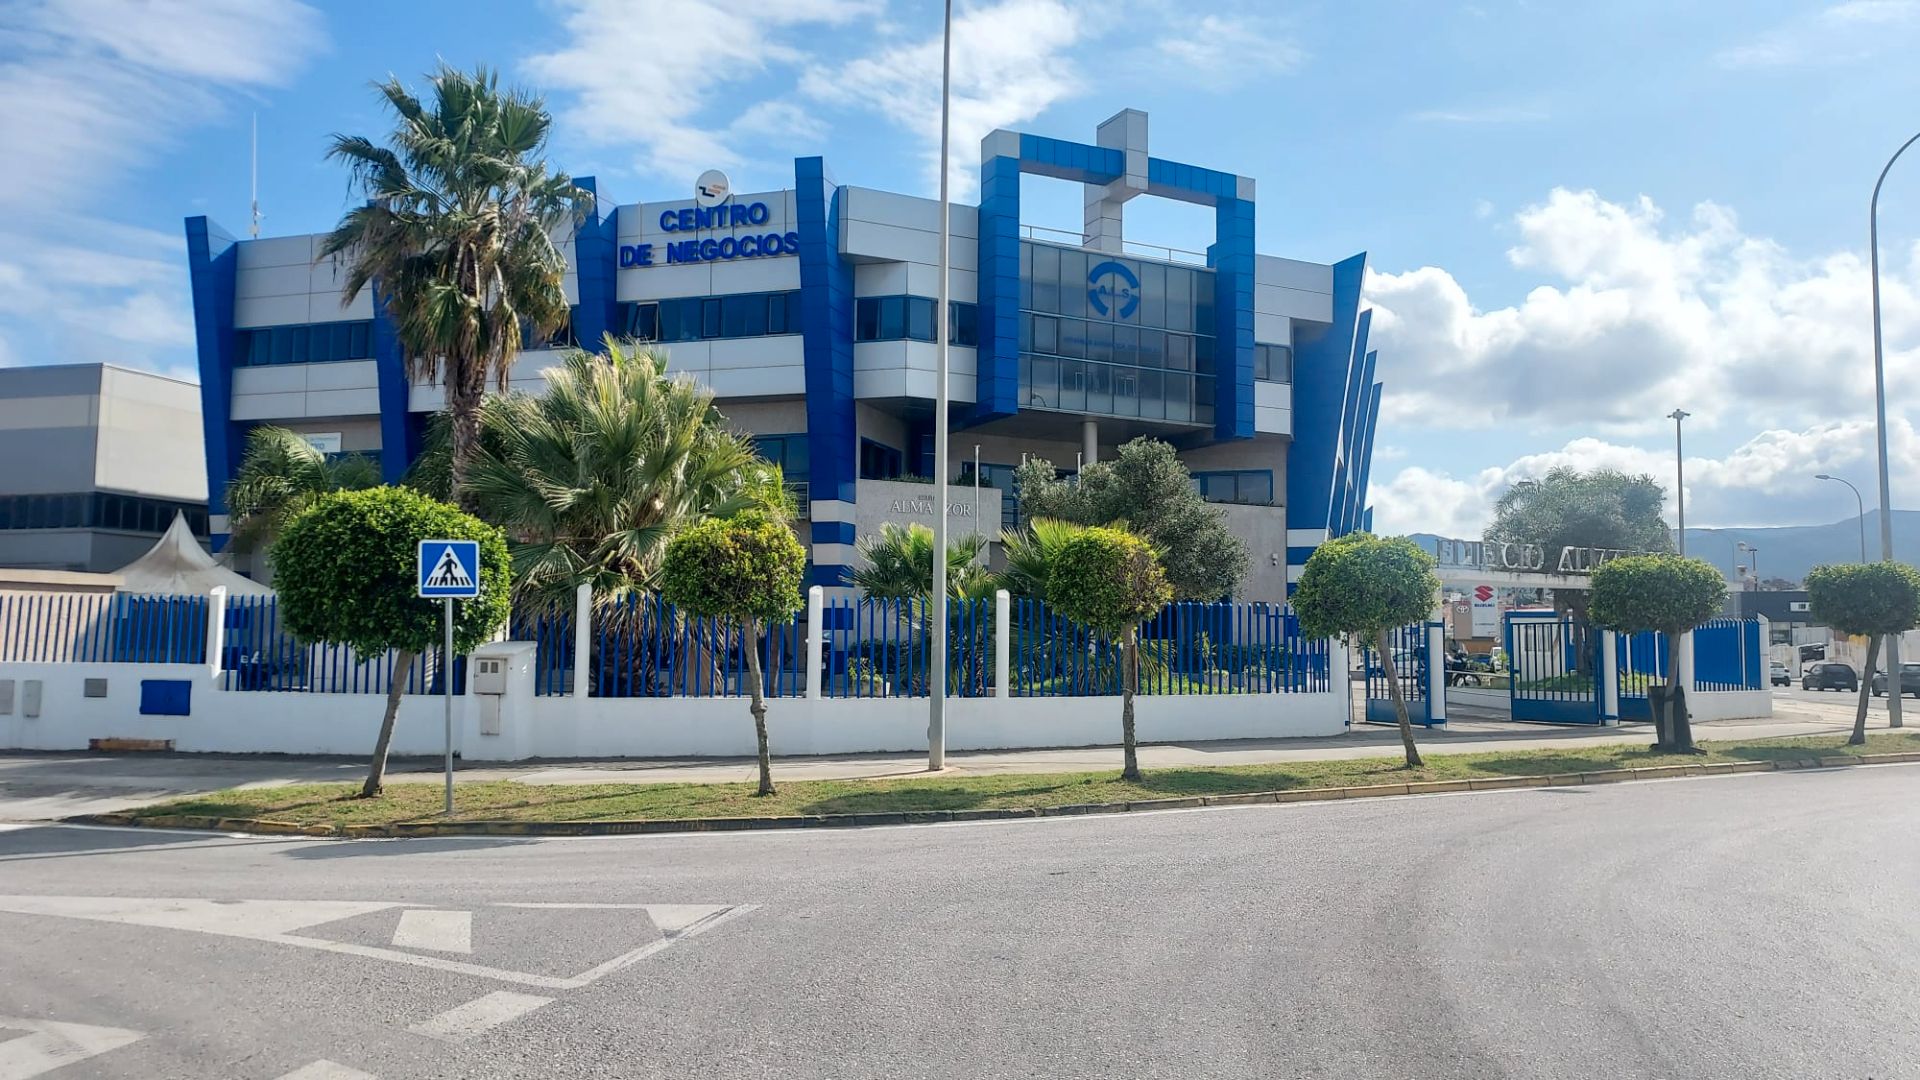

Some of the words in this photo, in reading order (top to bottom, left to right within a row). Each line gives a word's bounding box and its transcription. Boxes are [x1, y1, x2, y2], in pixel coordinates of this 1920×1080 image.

[659, 202, 769, 232] CENTRO
[619, 243, 653, 268] DE
[666, 231, 799, 264] NEGOCIOS
[890, 499, 971, 517] ALMAZOR
